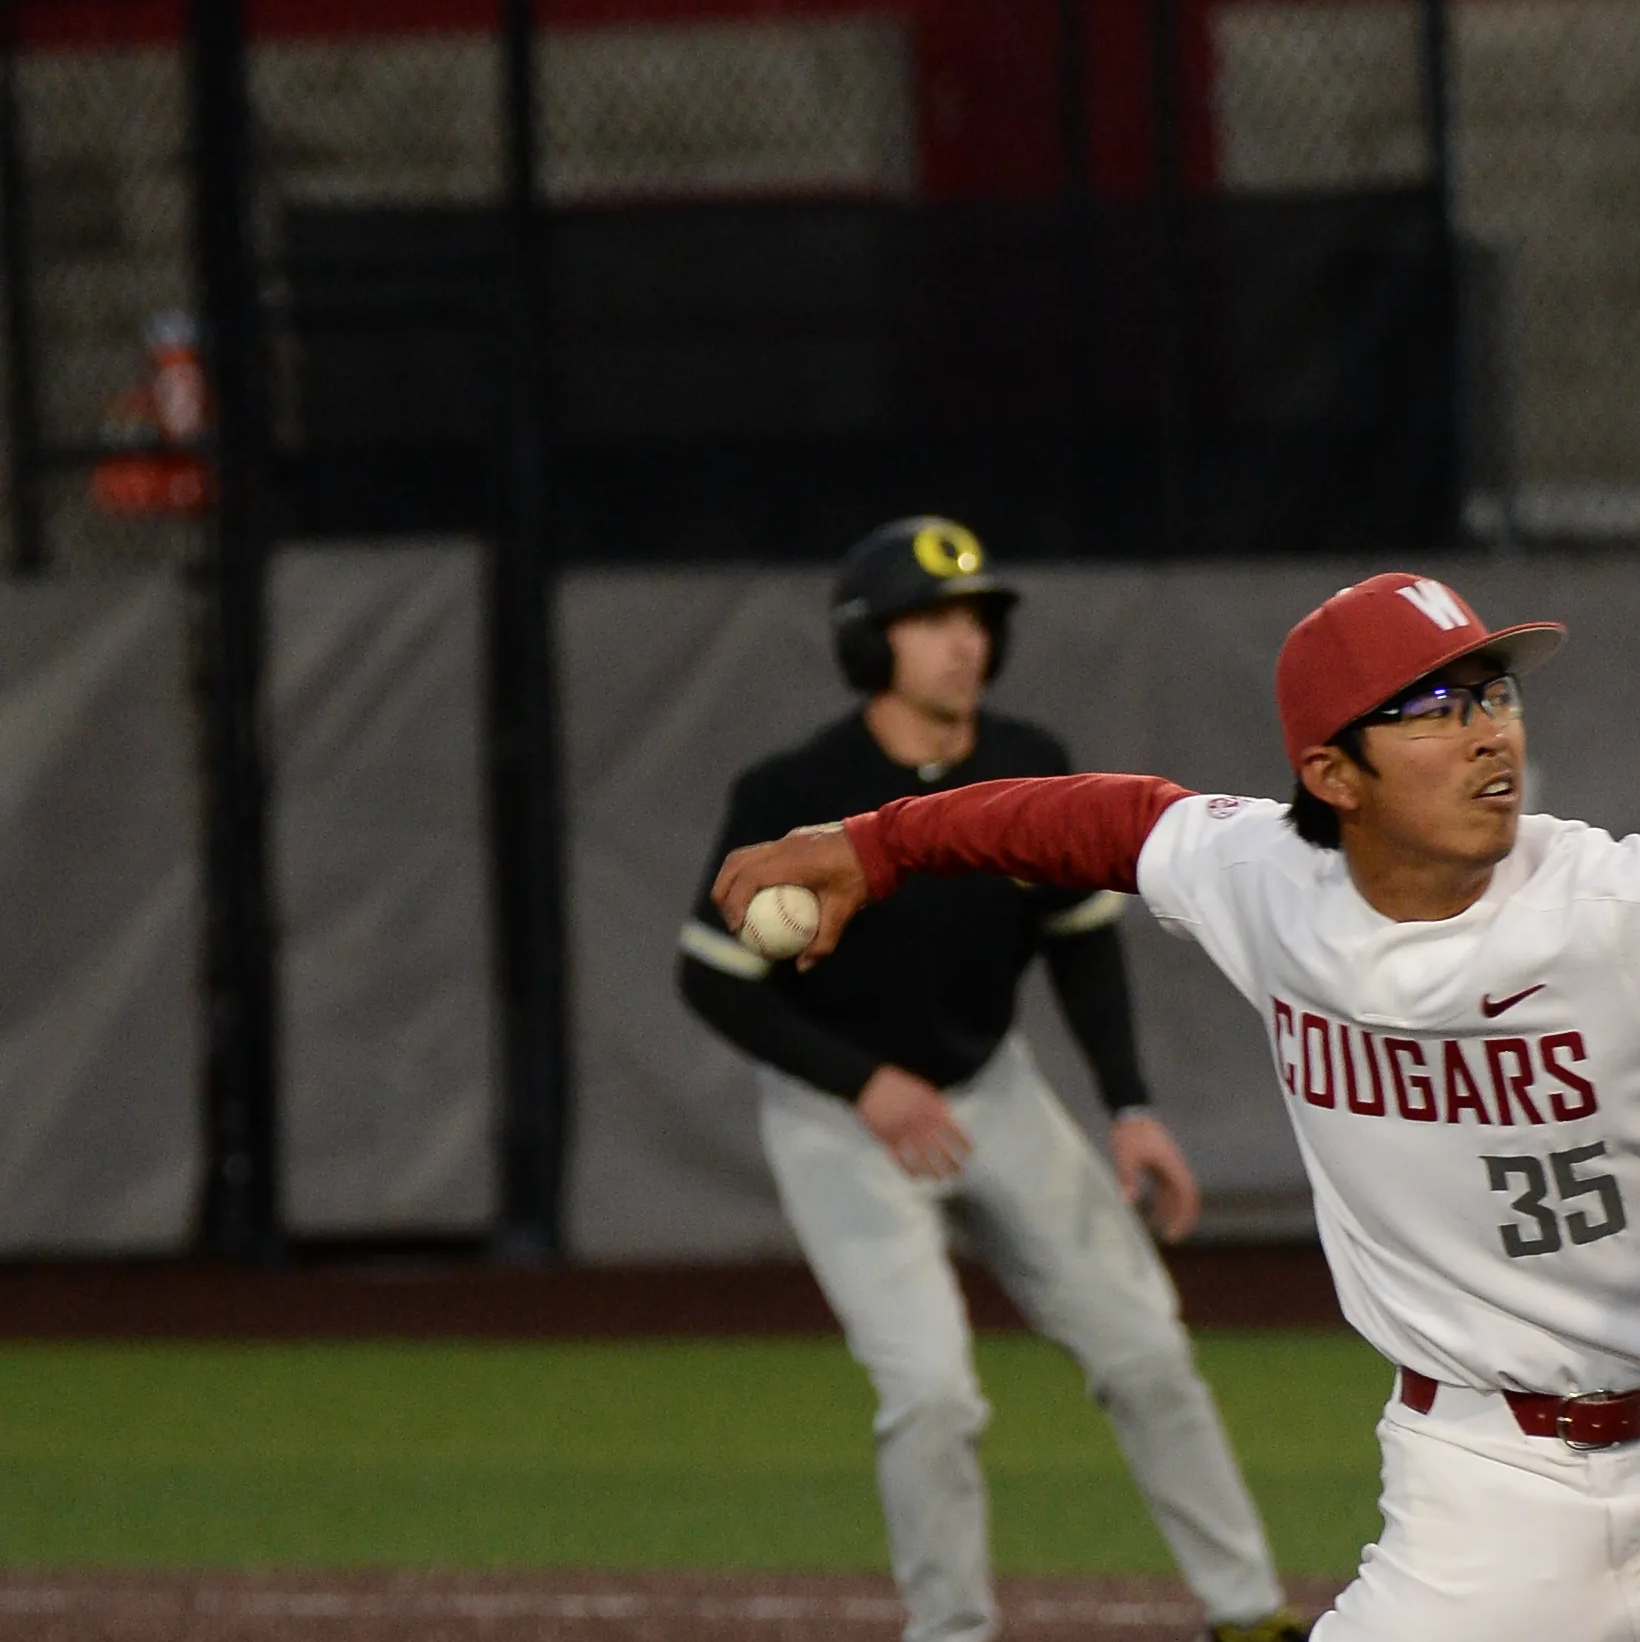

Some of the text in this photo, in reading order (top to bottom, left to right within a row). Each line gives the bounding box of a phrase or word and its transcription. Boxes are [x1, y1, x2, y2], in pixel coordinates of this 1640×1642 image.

[1393, 579, 1471, 632] W
[1269, 992, 1599, 1127] COUGARS
[1478, 1140, 1627, 1259] 35
